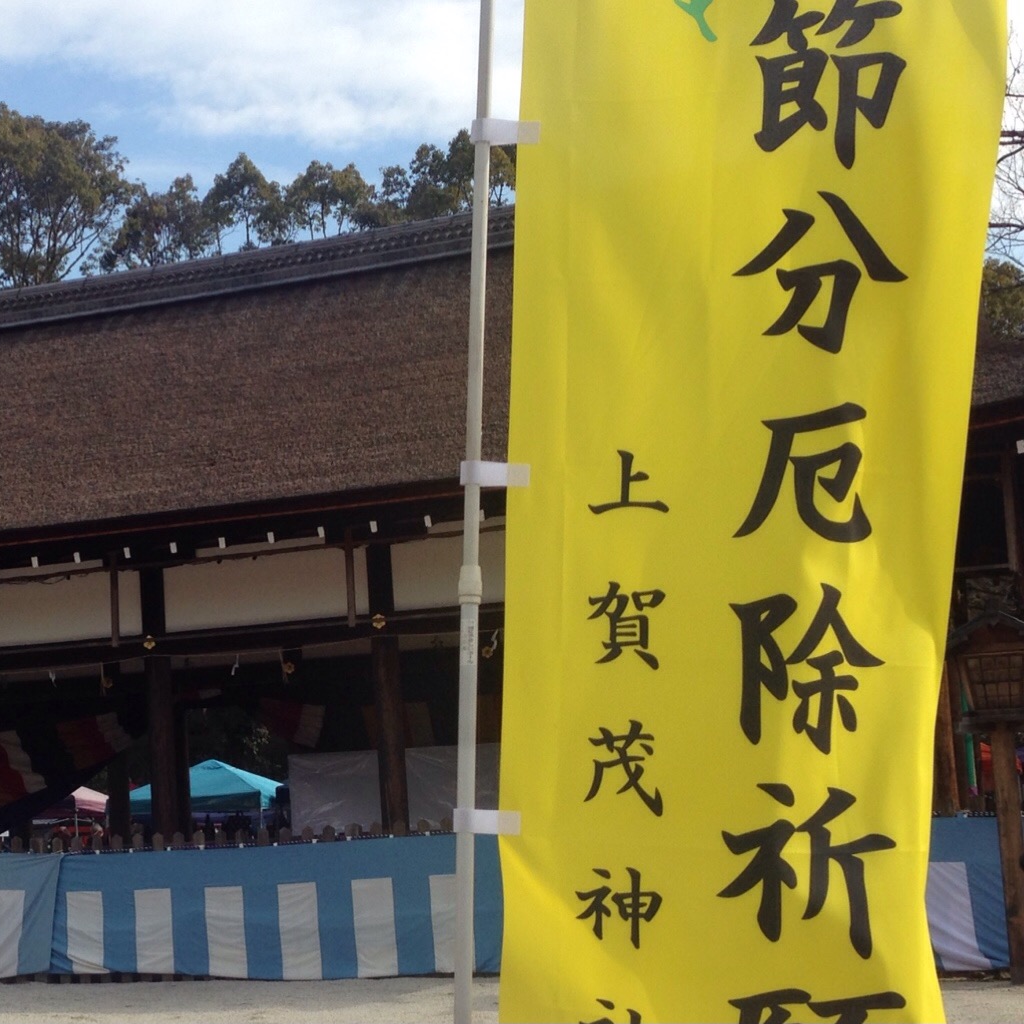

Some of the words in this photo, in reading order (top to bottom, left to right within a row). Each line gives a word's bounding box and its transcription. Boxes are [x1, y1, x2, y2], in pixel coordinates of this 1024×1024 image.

[575, 450, 670, 1023] 上賀茂神
[716, 0, 908, 1023] 節分厄除祈
